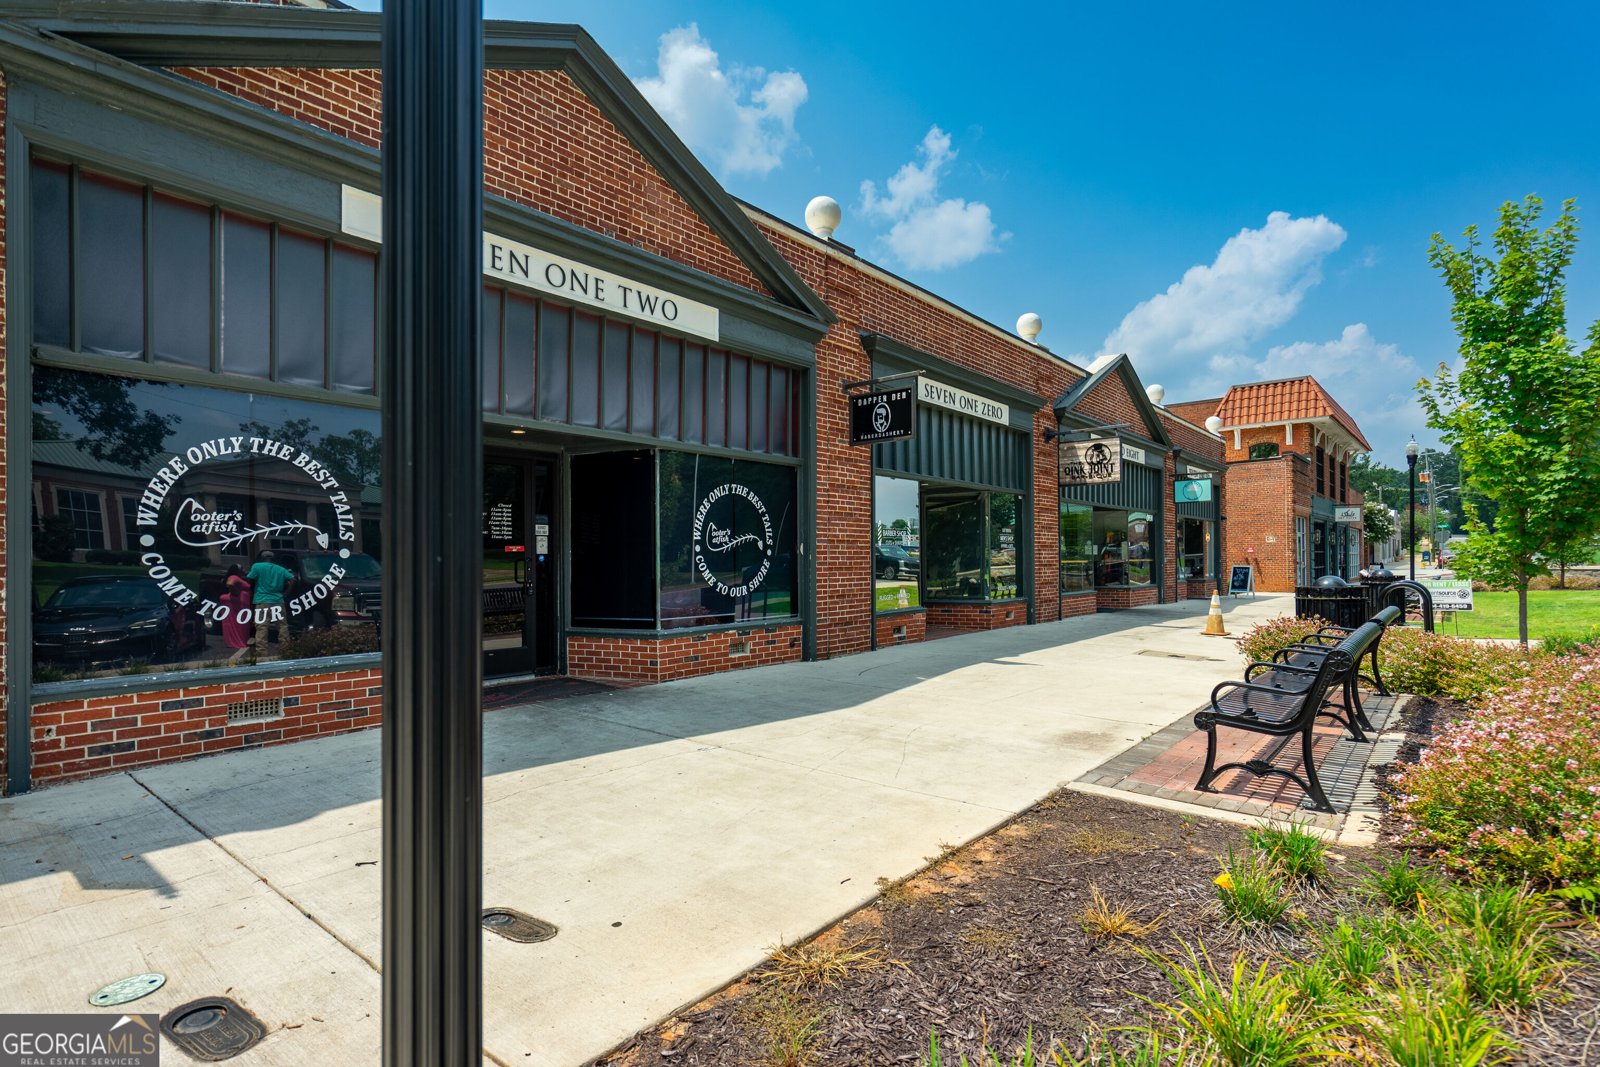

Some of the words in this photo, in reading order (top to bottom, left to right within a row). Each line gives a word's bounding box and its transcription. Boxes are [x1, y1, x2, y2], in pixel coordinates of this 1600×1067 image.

[545, 263, 605, 301] ONE
[618, 284, 678, 321] TWO
[858, 394, 887, 407] DAPPER
[891, 391, 907, 401] DEN
[925, 383, 956, 406] SEVEN
[959, 395, 979, 413] ONE
[981, 402, 1003, 420] ZERO
[860, 429, 904, 440] HABERDASHERY
[1064, 464, 1087, 476] OINK
[1088, 463, 1115, 475] JOINT
[1126, 448, 1140, 460] EIGHT
[136, 456, 189, 526] WHERE
[186, 436, 244, 464] ONLY
[249, 437, 295, 461] THE
[292, 452, 339, 490] BEST
[330, 491, 355, 542] TAILS
[693, 498, 711, 540] WHERE
[709, 484, 730, 503] ONLY
[731, 484, 749, 497] THE
[747, 492, 767, 514] BEST
[762, 514, 773, 546] TAILS
[882, 529, 897, 537] BARBER
[141, 552, 198, 607] COME
[196, 599, 230, 621] TO
[236, 605, 284, 625] OUR
[289, 562, 346, 617] SHORE
[695, 555, 717, 586] COME
[716, 582, 728, 595] TO
[730, 585, 748, 597] OUR
[749, 559, 771, 592] SHORE
